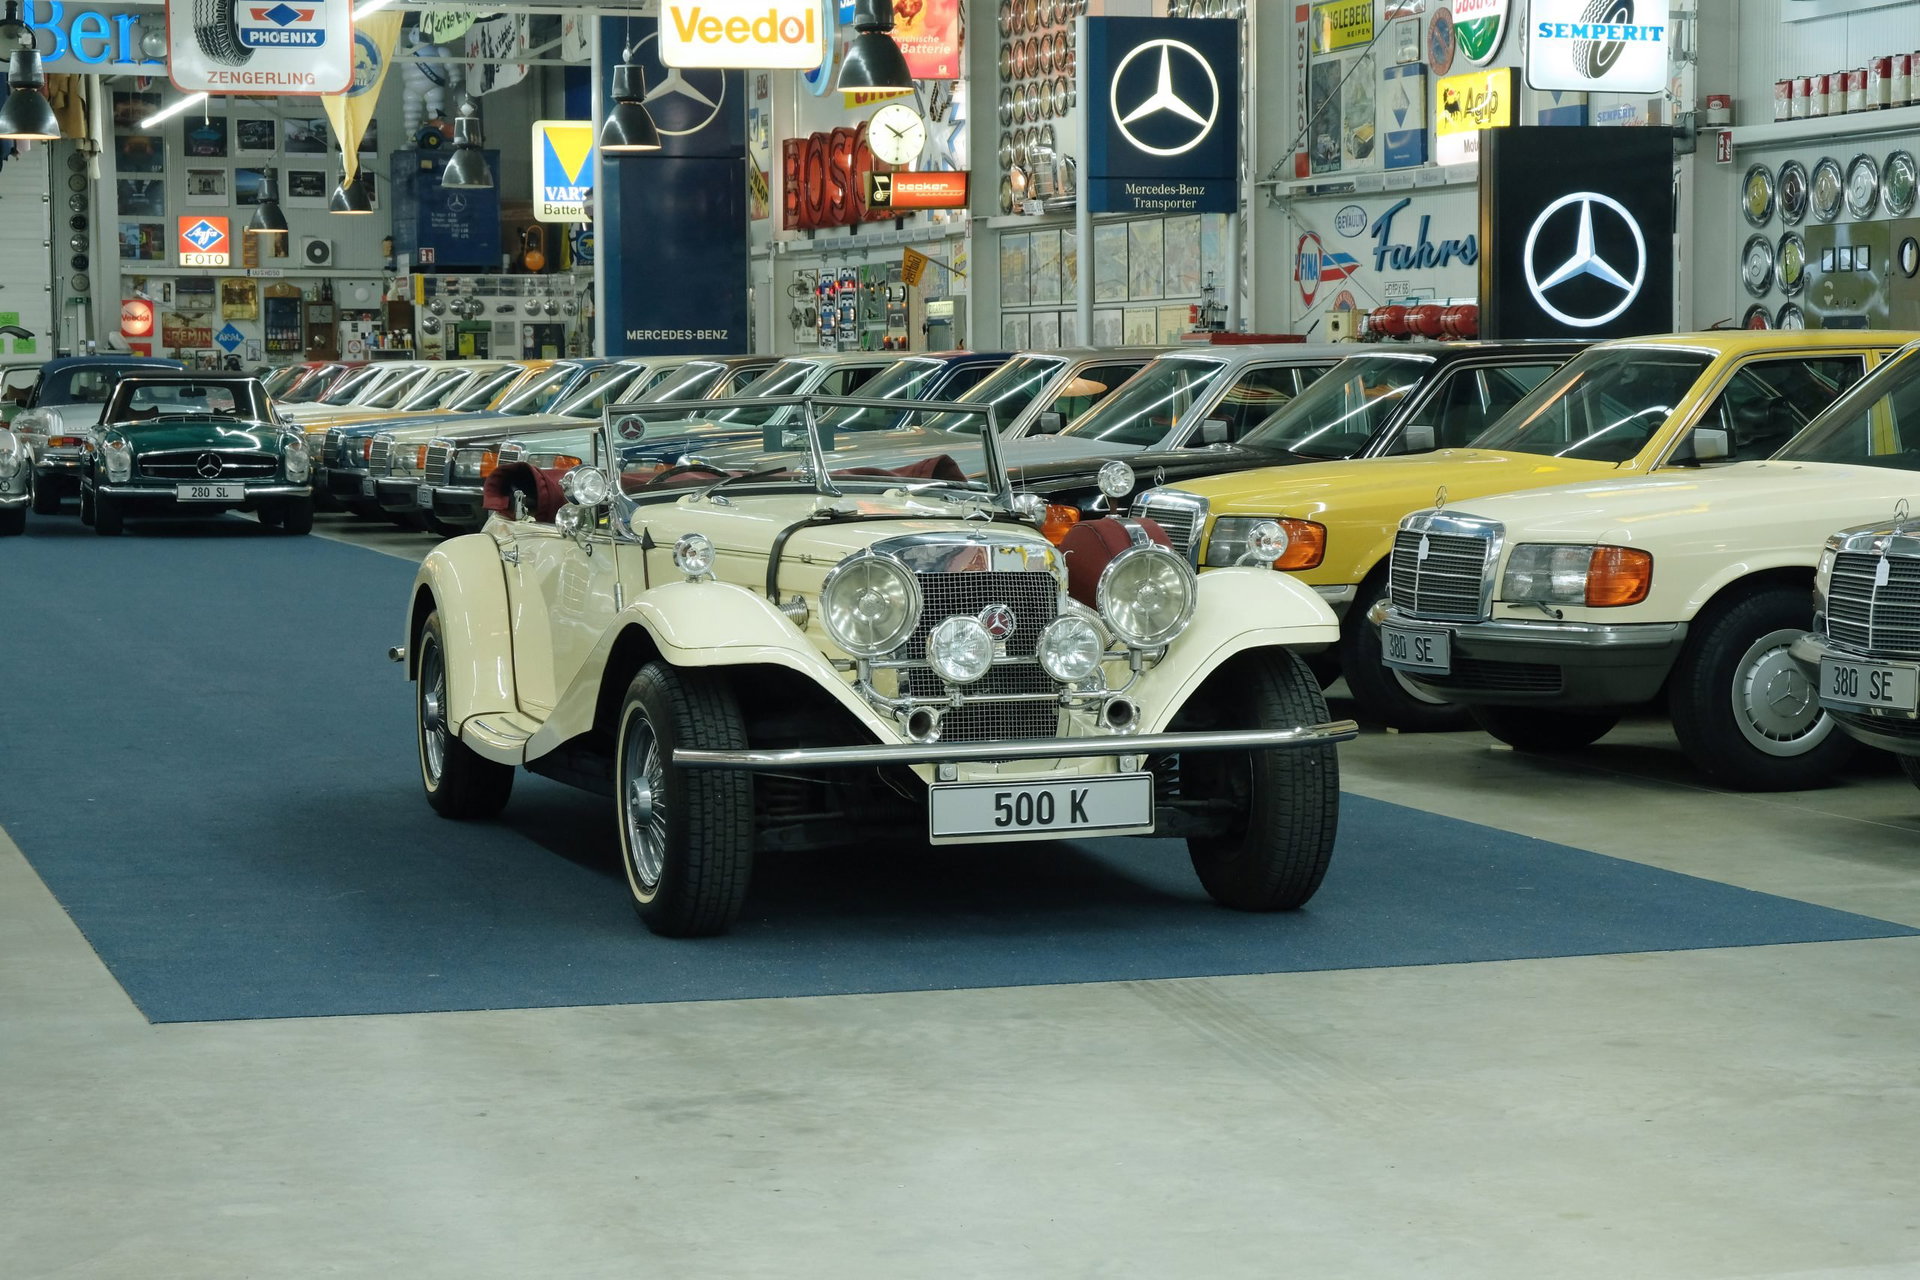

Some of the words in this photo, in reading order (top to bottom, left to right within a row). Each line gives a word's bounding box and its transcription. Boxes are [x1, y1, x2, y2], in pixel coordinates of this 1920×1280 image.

[1327, 2, 1373, 30] NGLEBERT
[669, 6, 815, 44] Veedol
[1538, 22, 1664, 42] SEMPERIT
[23, 0, 167, 65] Ber
[250, 31, 317, 44] PHOENIX
[1346, 28, 1371, 38] REIFEN
[900, 44, 951, 55] Batterie
[207, 71, 316, 85] ZENGERLING
[1464, 86, 1499, 124] Agip
[897, 182, 949, 191] becker
[1125, 183, 1206, 196] Mercedes-Benz
[545, 187, 591, 201] VART
[544, 204, 586, 215] Batter
[1133, 197, 1197, 210] Transporter
[1371, 198, 1479, 273] Fahrs
[185, 254, 225, 265] FOTO
[1300, 252, 1319, 282] FINA
[121, 313, 150, 323] Veedol
[626, 329, 729, 341] MERCEDES-BENZ
[191, 486, 210, 498] 280
[215, 486, 229, 498] SL
[1388, 632, 1407, 660] 380
[1414, 635, 1434, 663] SE
[1833, 665, 1858, 698] 380
[1869, 670, 1894, 702] SE
[994, 790, 1055, 827] 500
[1070, 788, 1090, 824] K
